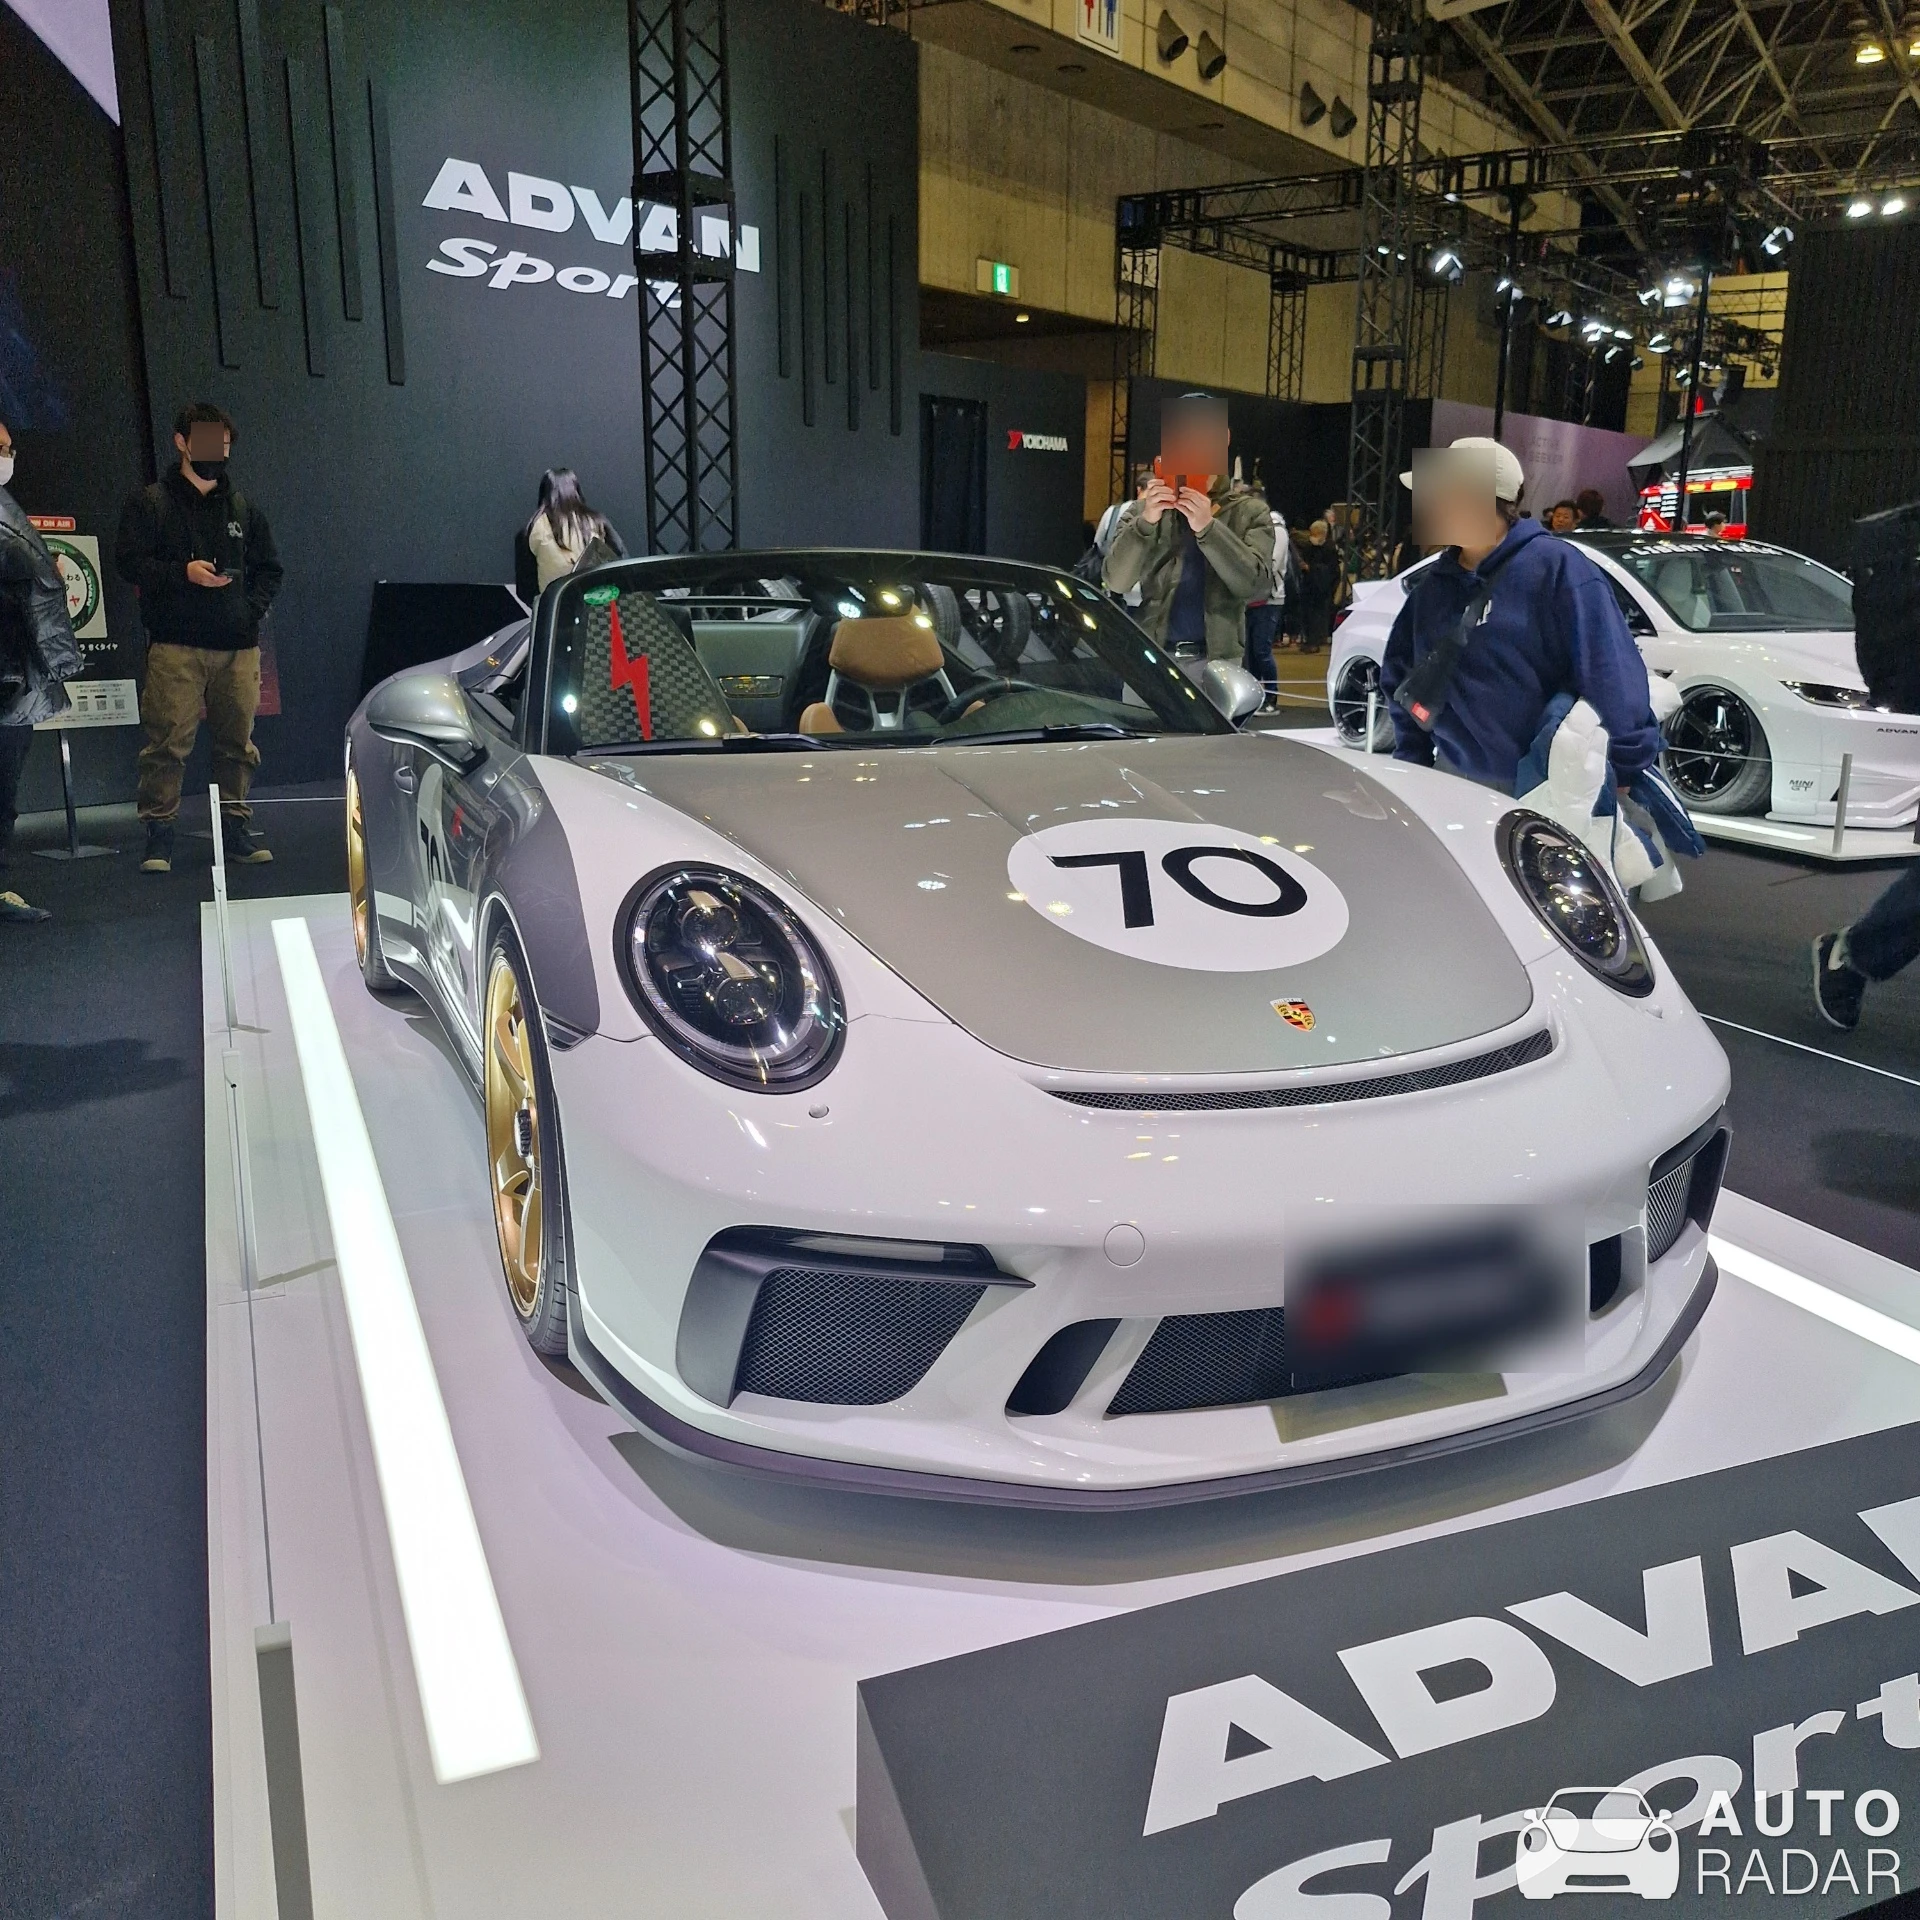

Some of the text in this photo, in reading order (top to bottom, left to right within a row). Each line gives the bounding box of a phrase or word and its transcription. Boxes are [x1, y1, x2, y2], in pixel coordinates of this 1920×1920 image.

[421, 157, 760, 273] ADVAN
[1022, 434, 1068, 451] YOKOHAMA
[43, 519, 55, 527] ON
[56, 519, 71, 528] AIR
[1876, 727, 1919, 735] ADVAN
[1789, 779, 1814, 788] MINI
[1045, 845, 1308, 929] 70
